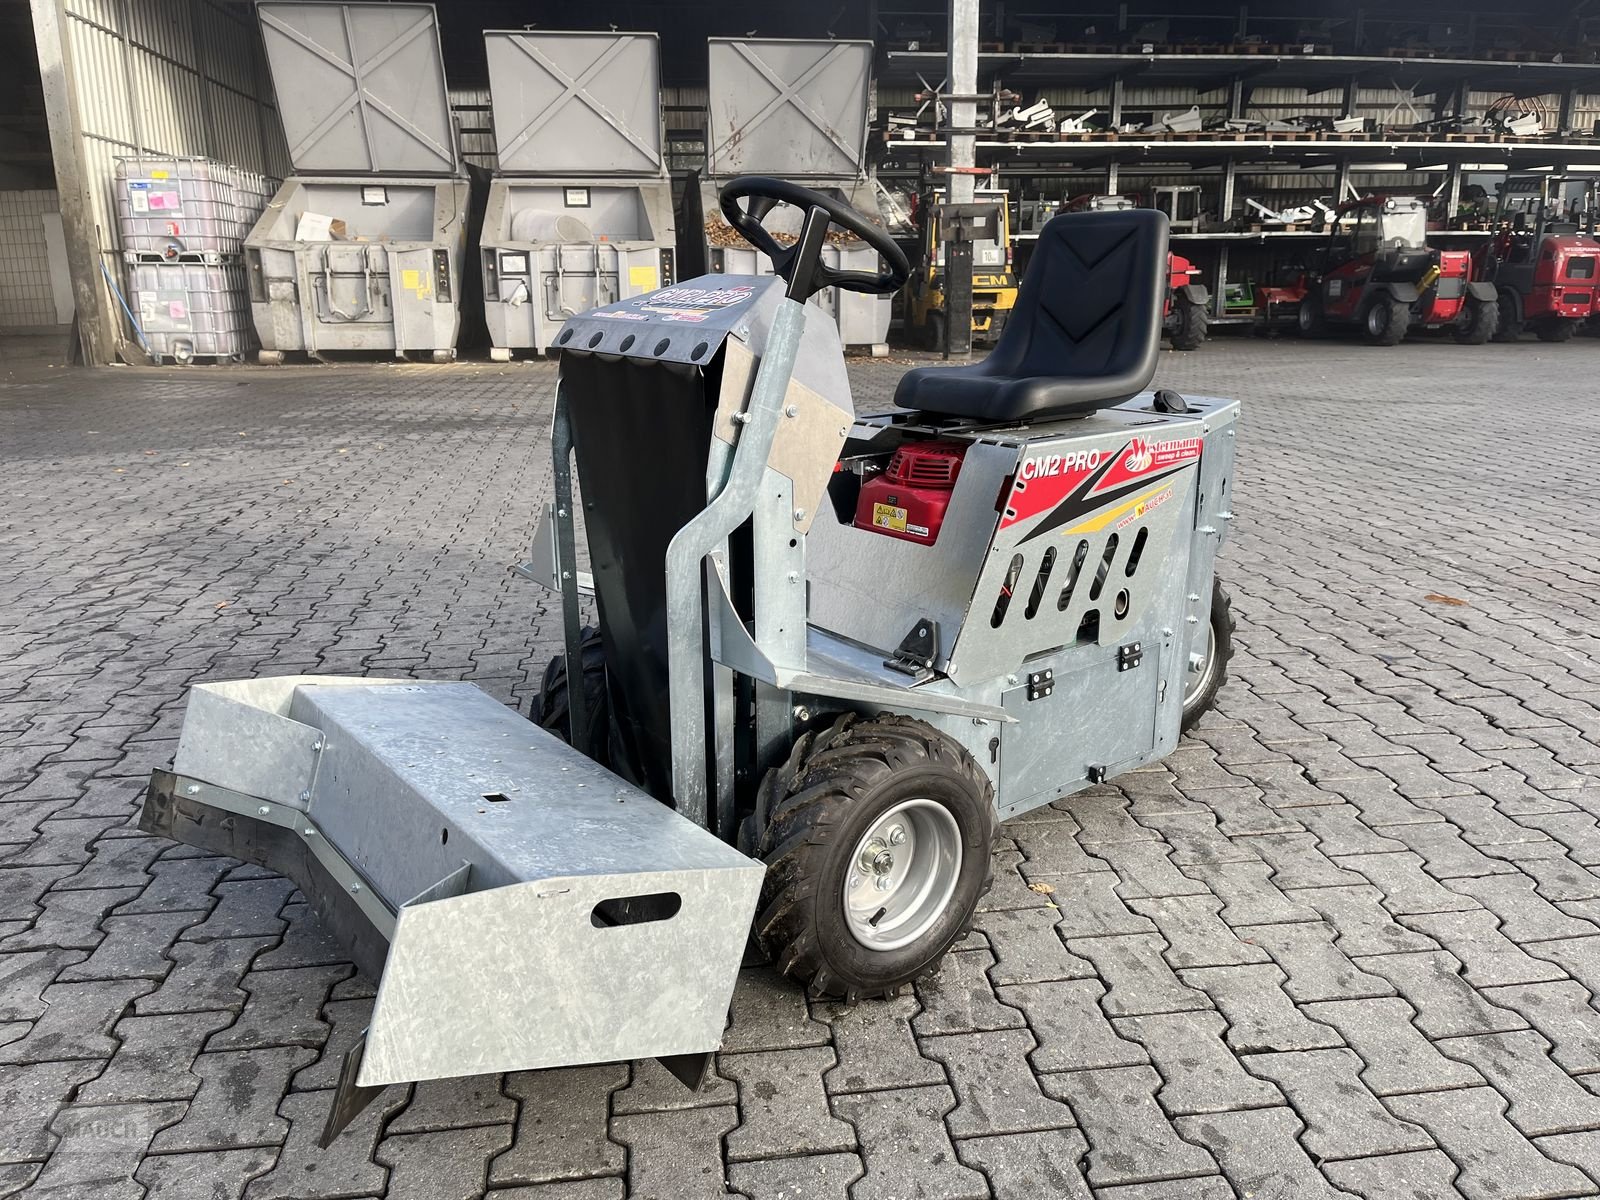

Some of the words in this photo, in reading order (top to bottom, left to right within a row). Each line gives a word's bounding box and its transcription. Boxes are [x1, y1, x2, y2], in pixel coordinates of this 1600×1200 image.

[1131, 435, 1200, 458] Westermann
[1157, 452, 1176, 461] sweep
[1021, 453, 1060, 480] CM2
[1063, 448, 1101, 473] PRO
